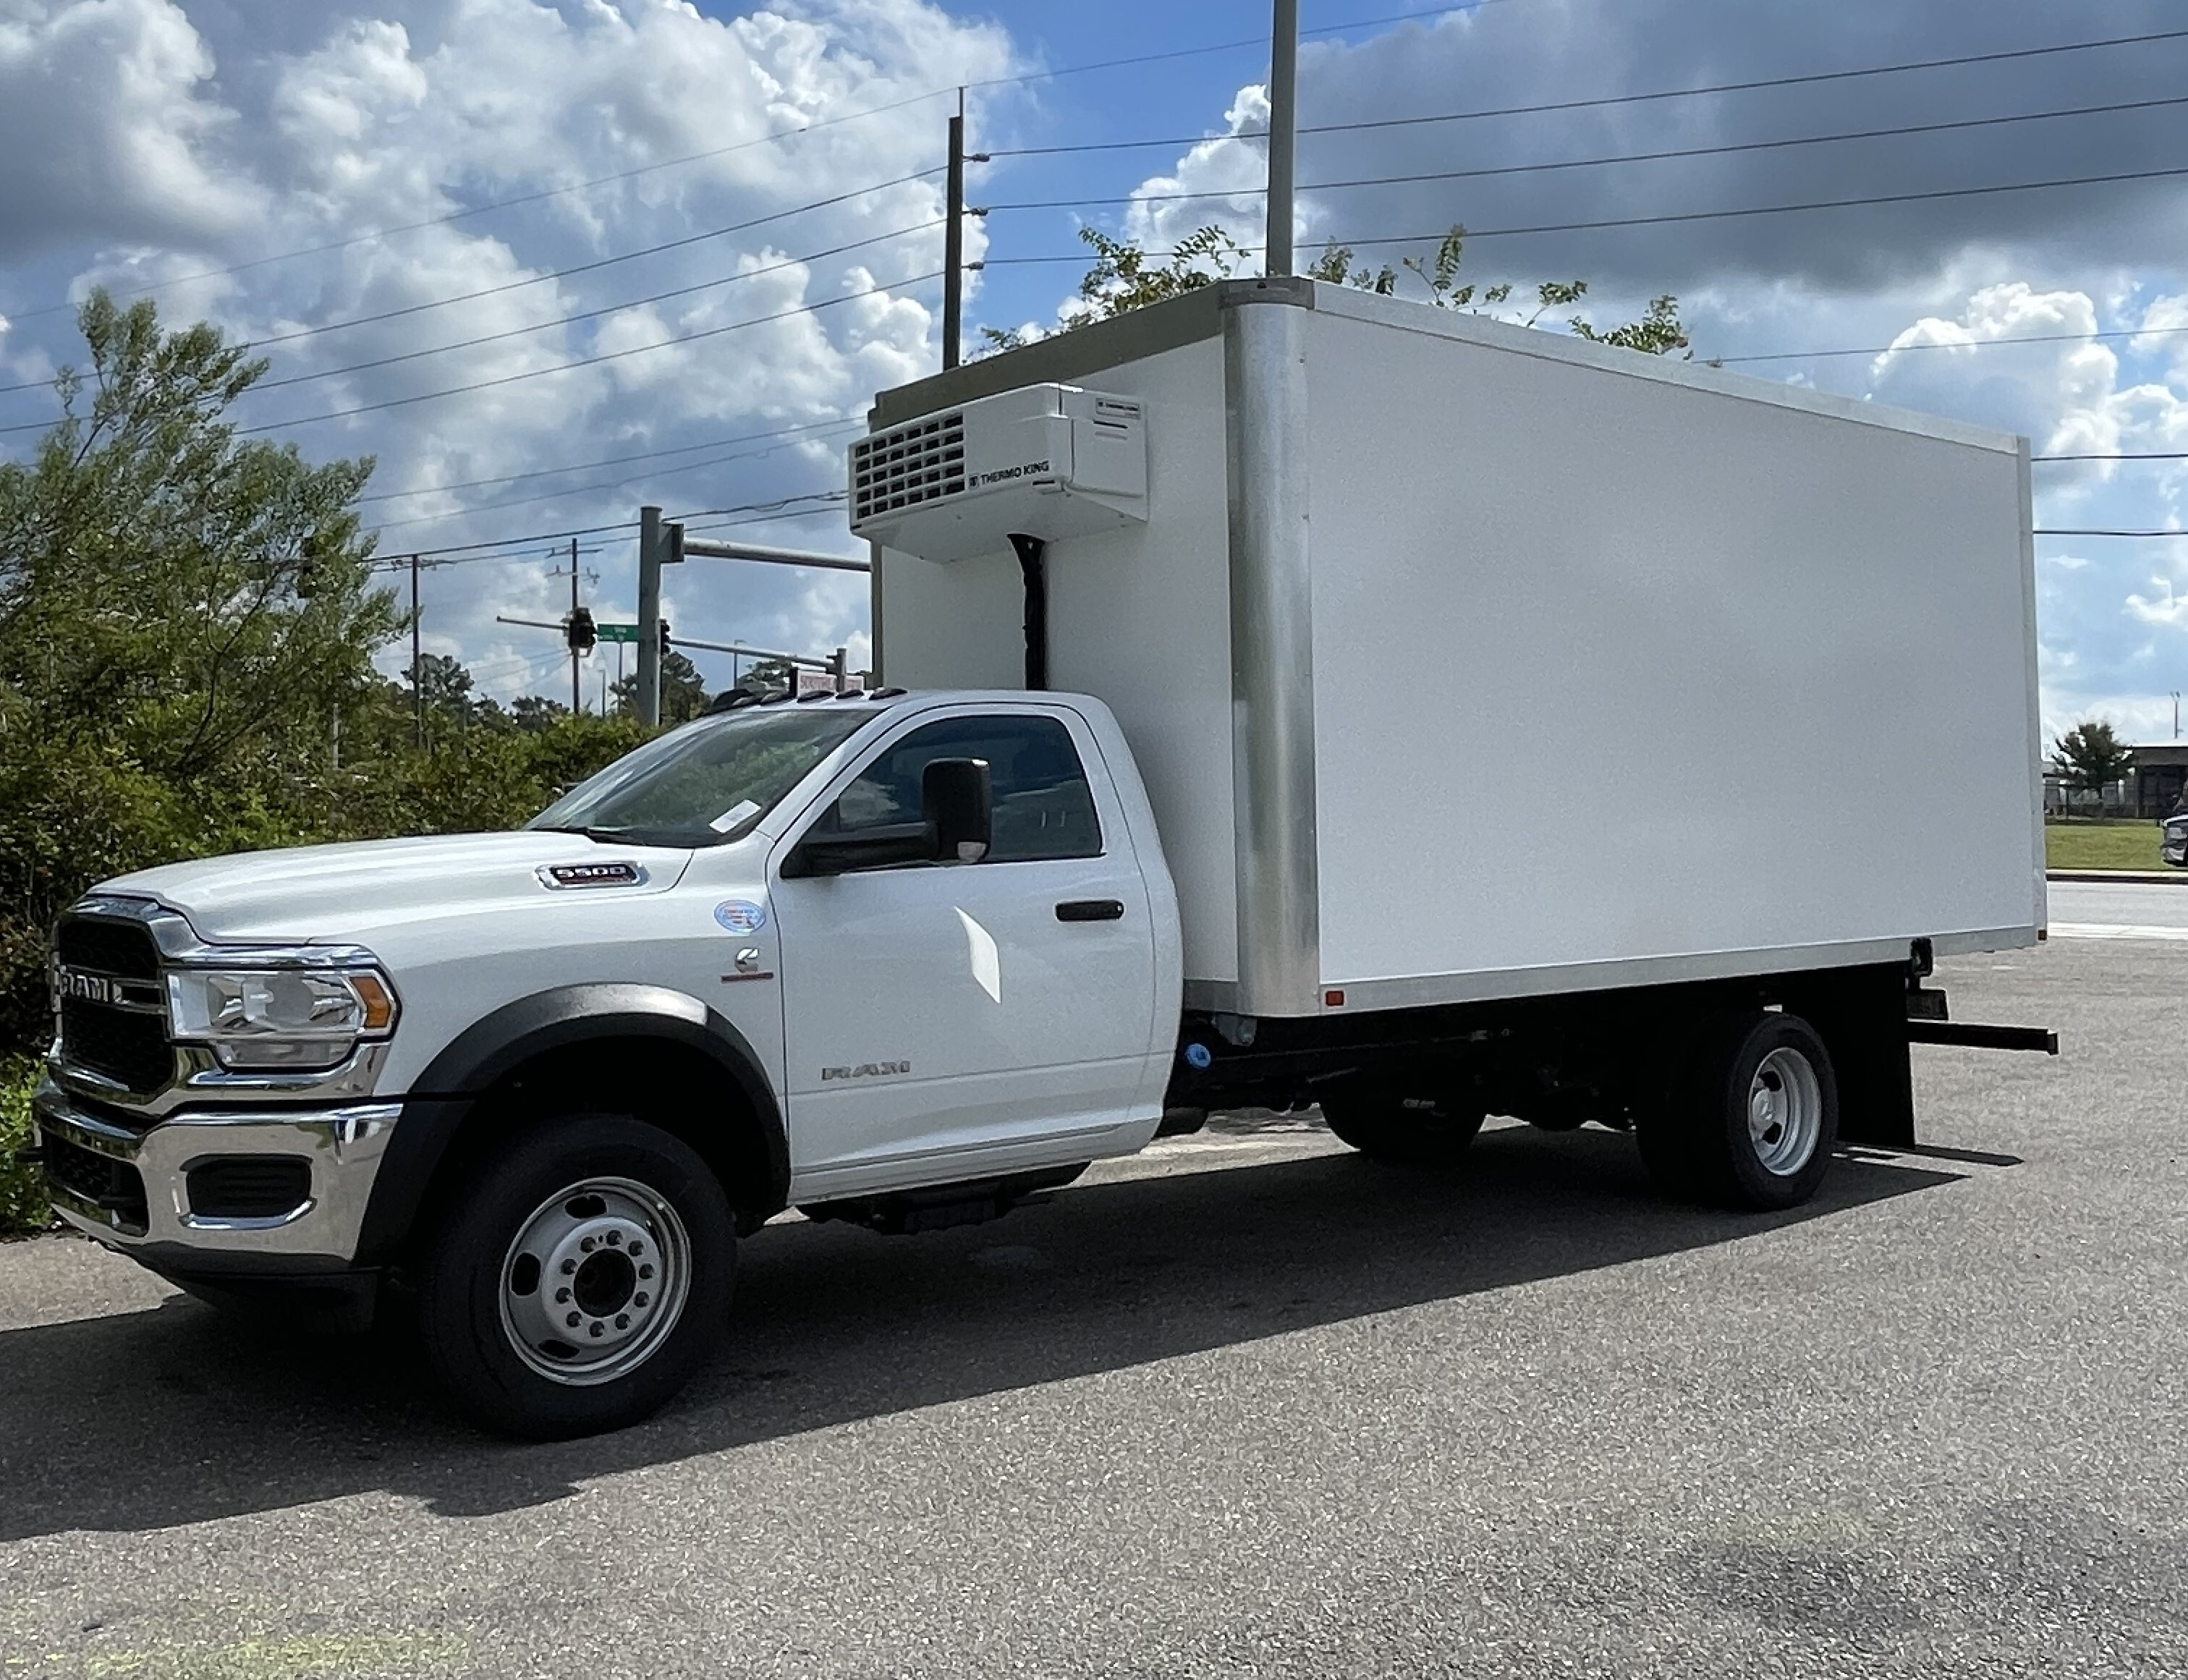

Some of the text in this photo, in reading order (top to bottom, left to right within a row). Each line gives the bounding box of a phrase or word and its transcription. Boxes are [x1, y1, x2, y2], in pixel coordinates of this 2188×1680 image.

[980, 467, 1022, 485] THERMO
[1024, 460, 1049, 475] KING
[556, 866, 626, 878] 5500
[60, 973, 109, 1002] RAM
[821, 1061, 910, 1080] RAM
